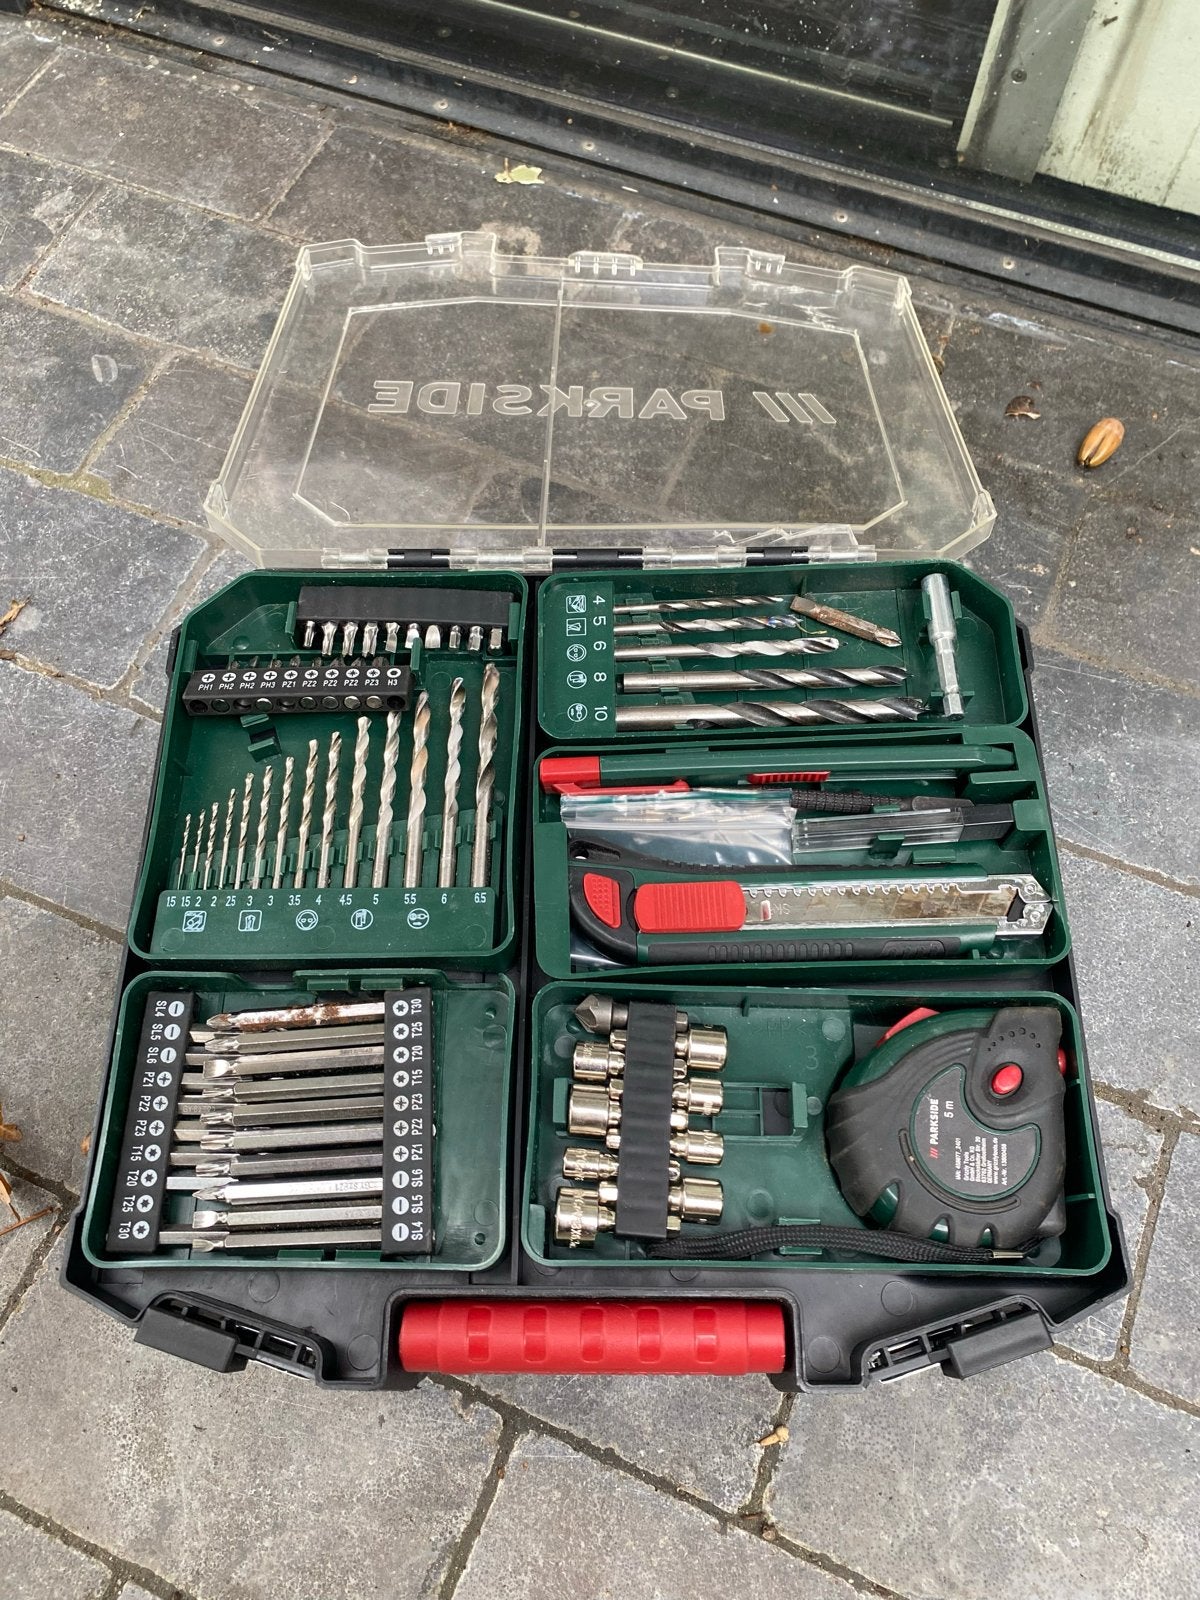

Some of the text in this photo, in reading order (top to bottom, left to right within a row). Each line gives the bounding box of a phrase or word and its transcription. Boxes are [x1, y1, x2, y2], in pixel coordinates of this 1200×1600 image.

[593, 595, 607, 721] 4 5 6 8 10
[198, 682, 213, 690] PH1
[195, 896, 201, 907] 2
[211, 896, 217, 906] 2
[247, 896, 252, 906] 3
[268, 895, 273, 906] 3
[316, 895, 321, 905] 4
[373, 894, 378, 904] 5
[442, 894, 447, 904] 6
[118, 1001, 167, 1239] SL4 SL5 SL6 PZ1 PZ2 PZ3 T15 T20 T25 T30
[411, 999, 423, 1240] SL4 SL5 SL6 PZ1 PZ2 PZ3 T15 T20 T25 T30
[930, 1099, 938, 1145] PARKSIDE
[946, 1101, 953, 1109] m
